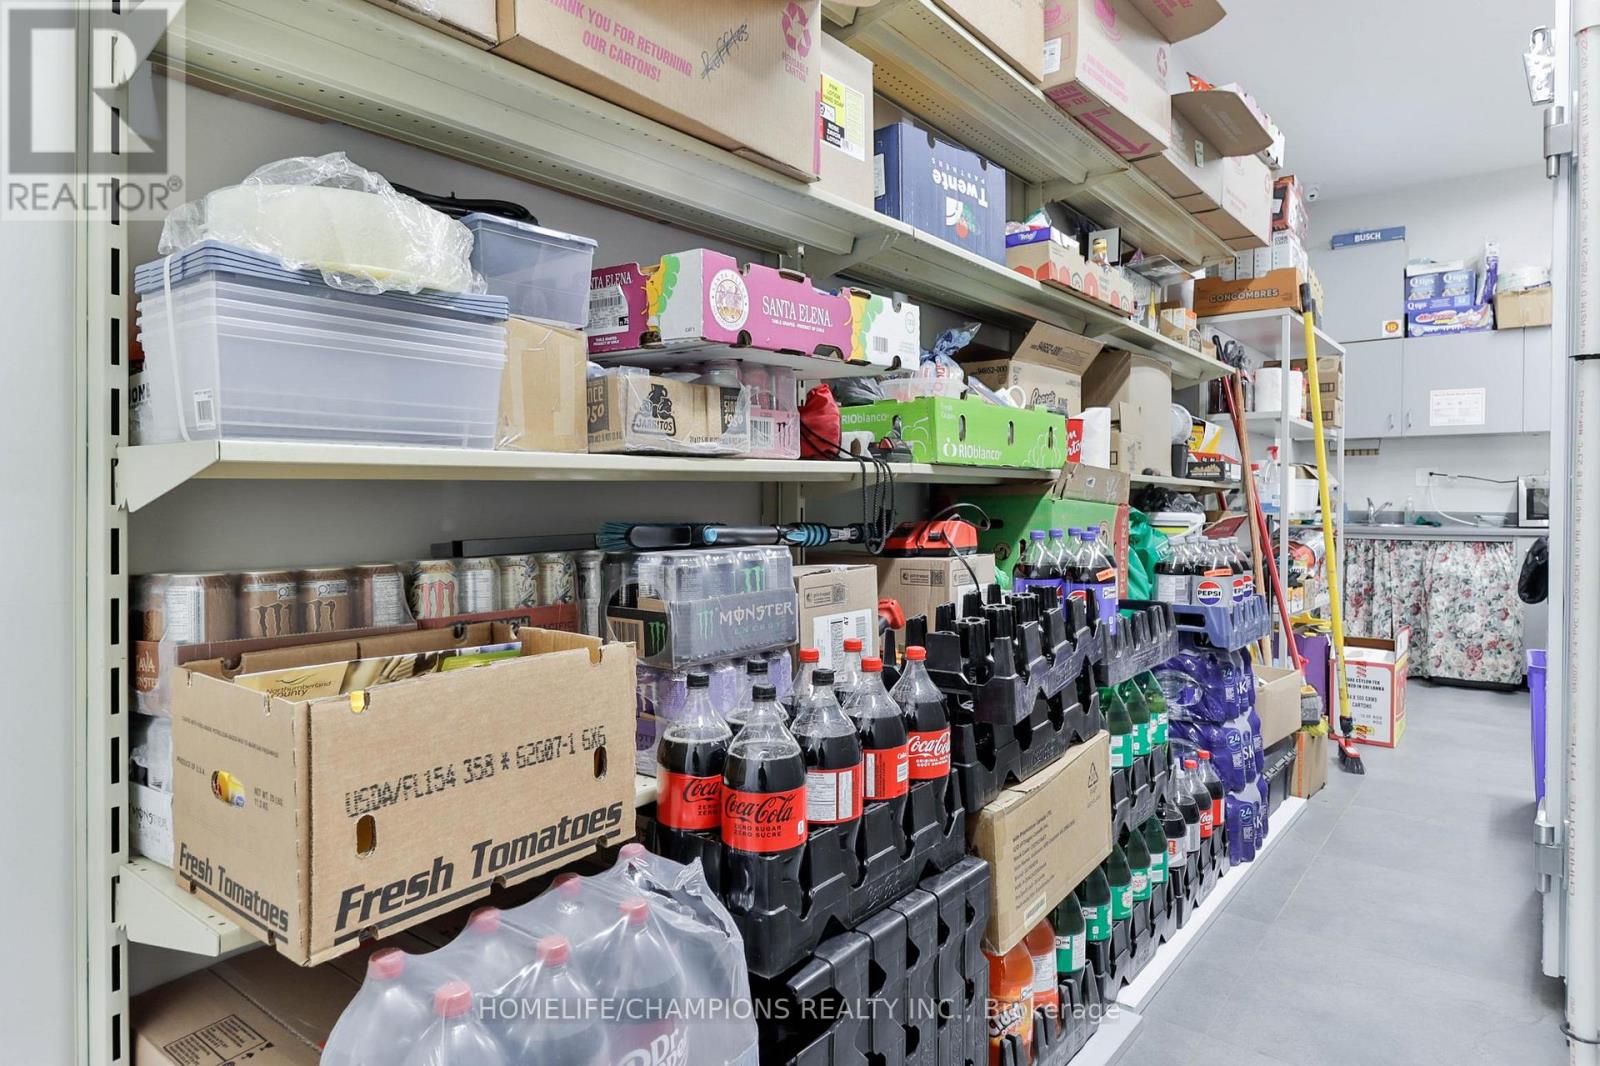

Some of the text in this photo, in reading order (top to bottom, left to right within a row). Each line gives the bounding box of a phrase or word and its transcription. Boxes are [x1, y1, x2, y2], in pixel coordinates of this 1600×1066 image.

[588, 7, 611, 33] YOU
[613, 22, 636, 45] FOR
[637, 33, 693, 77] RETURNING
[582, 29, 662, 83] OUR CARTONS!
[932, 168, 988, 208] Twente
[1354, 232, 1382, 243] BUSCH
[591, 271, 632, 290] NTA ELENA
[1209, 288, 1280, 304] CONCOMBRES
[762, 295, 832, 327] SANTA ELENA
[959, 444, 1000, 461] RIOblanco
[1197, 589, 1221, 597] PEPSI
[719, 601, 793, 625] MONSTER
[266, 681, 333, 695] Northumberland
[1228, 735, 1241, 745] 24
[463, 753, 496, 784] 358
[724, 793, 794, 824] Coca-Cola
[733, 824, 753, 832] ZERO
[733, 830, 753, 838] ZERO
[335, 800, 624, 932] Fresh Tomatoes
[179, 841, 290, 932] Fresh Tomatoes
